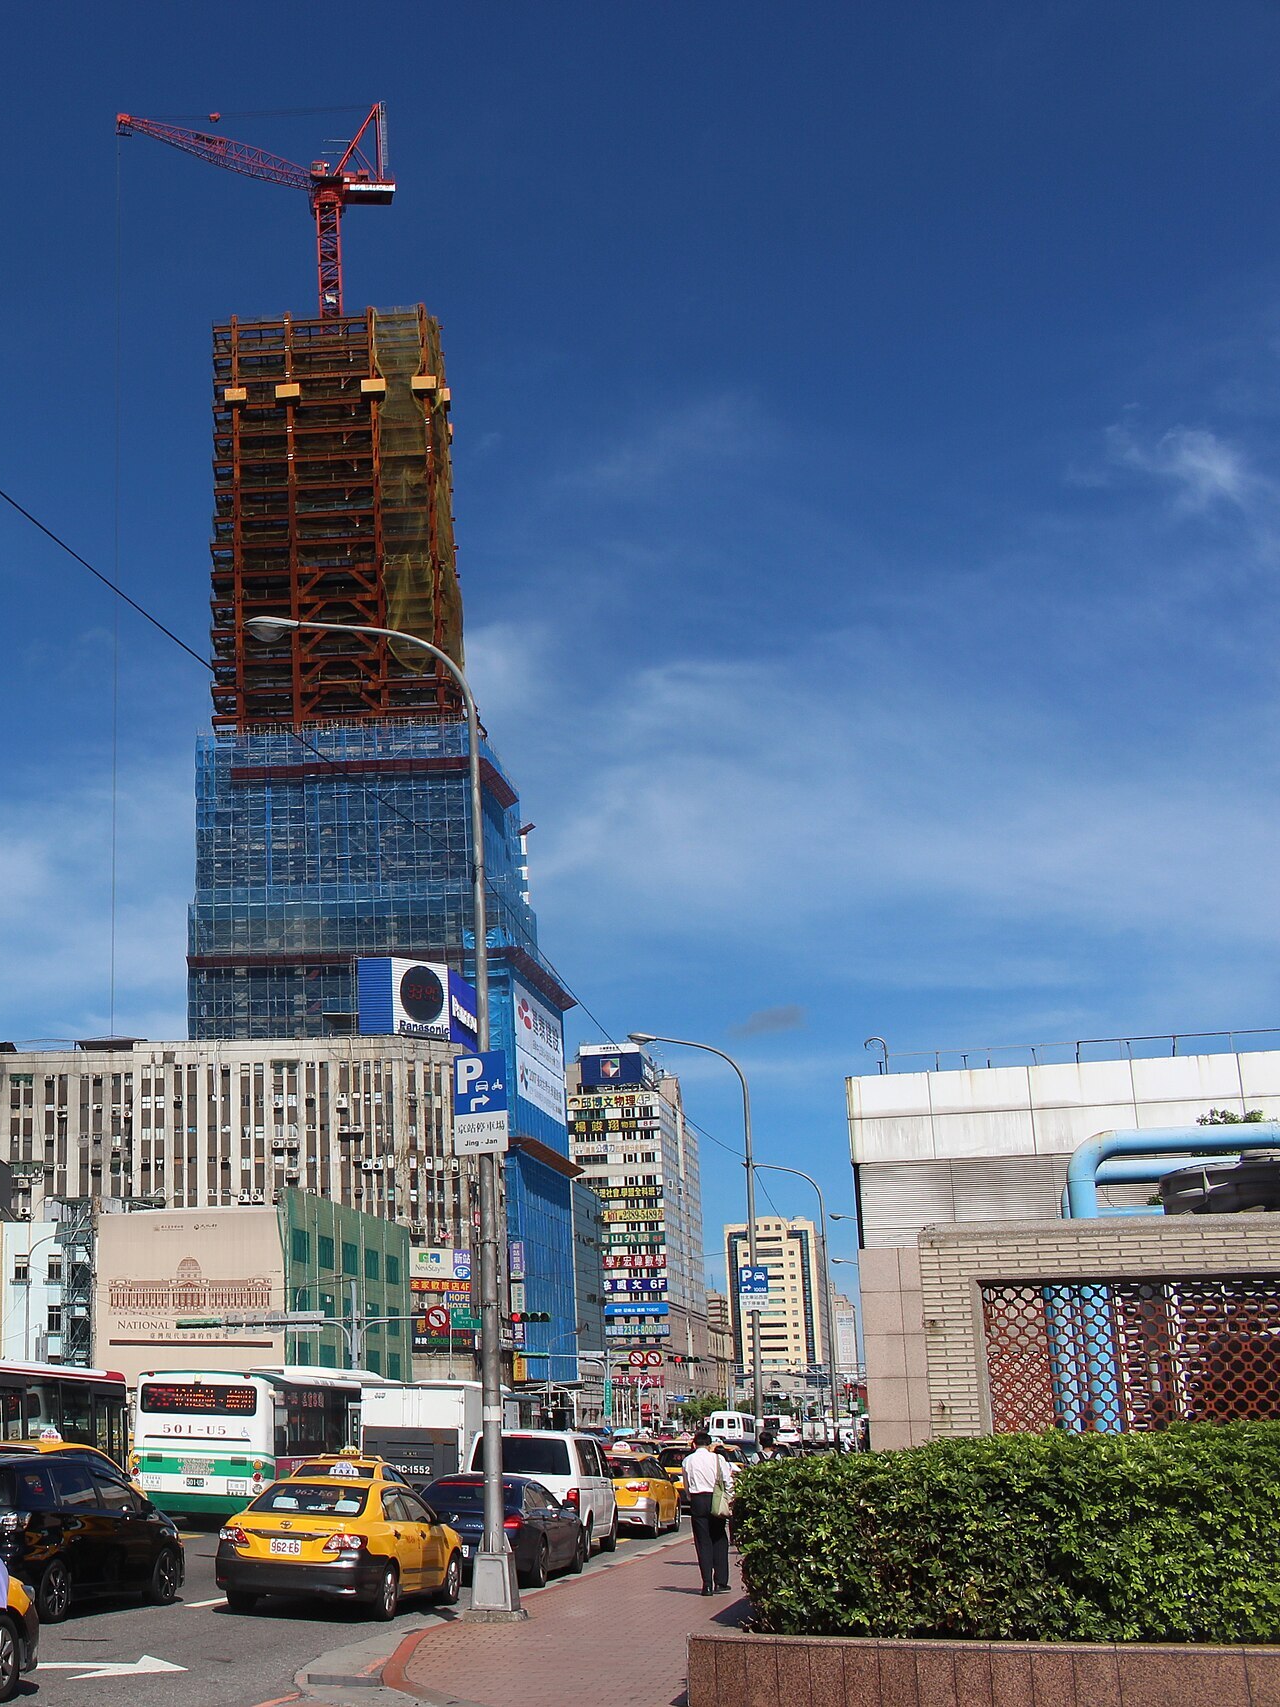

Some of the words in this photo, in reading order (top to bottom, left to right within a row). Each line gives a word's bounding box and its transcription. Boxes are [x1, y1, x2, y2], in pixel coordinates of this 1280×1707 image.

[399, 1019, 450, 1035] Panasonic
[457, 1057, 483, 1095] P
[649, 1279, 666, 1290] 6F
[449, 1294, 470, 1302] HOPE
[117, 1320, 170, 1330] NATIONAL
[163, 1423, 227, 1435] 501-U5
[272, 1541, 300, 1553] 962-E6
